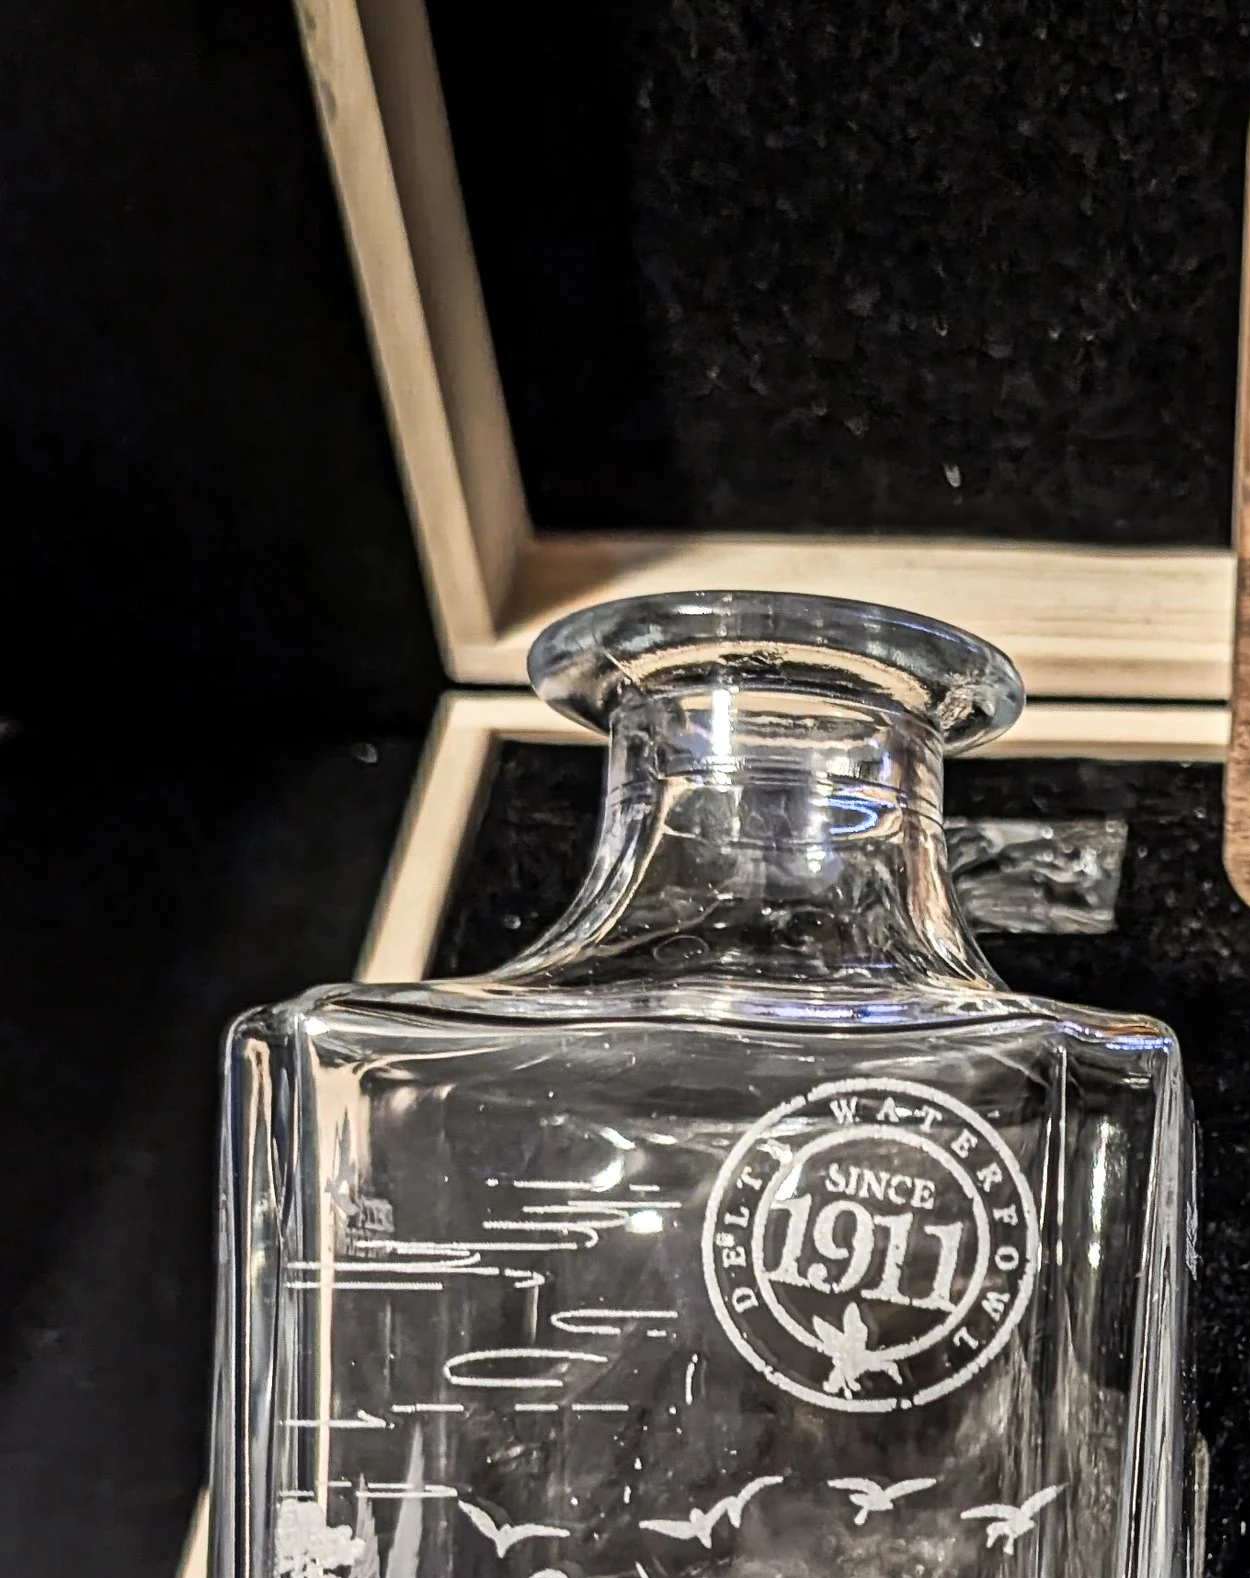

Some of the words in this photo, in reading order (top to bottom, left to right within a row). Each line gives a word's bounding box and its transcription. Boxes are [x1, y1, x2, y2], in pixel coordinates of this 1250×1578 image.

[826, 1163, 936, 1210] SINCE
[829, 1096, 1019, 1350] WATERFOWL
[770, 1193, 963, 1314] 1911
